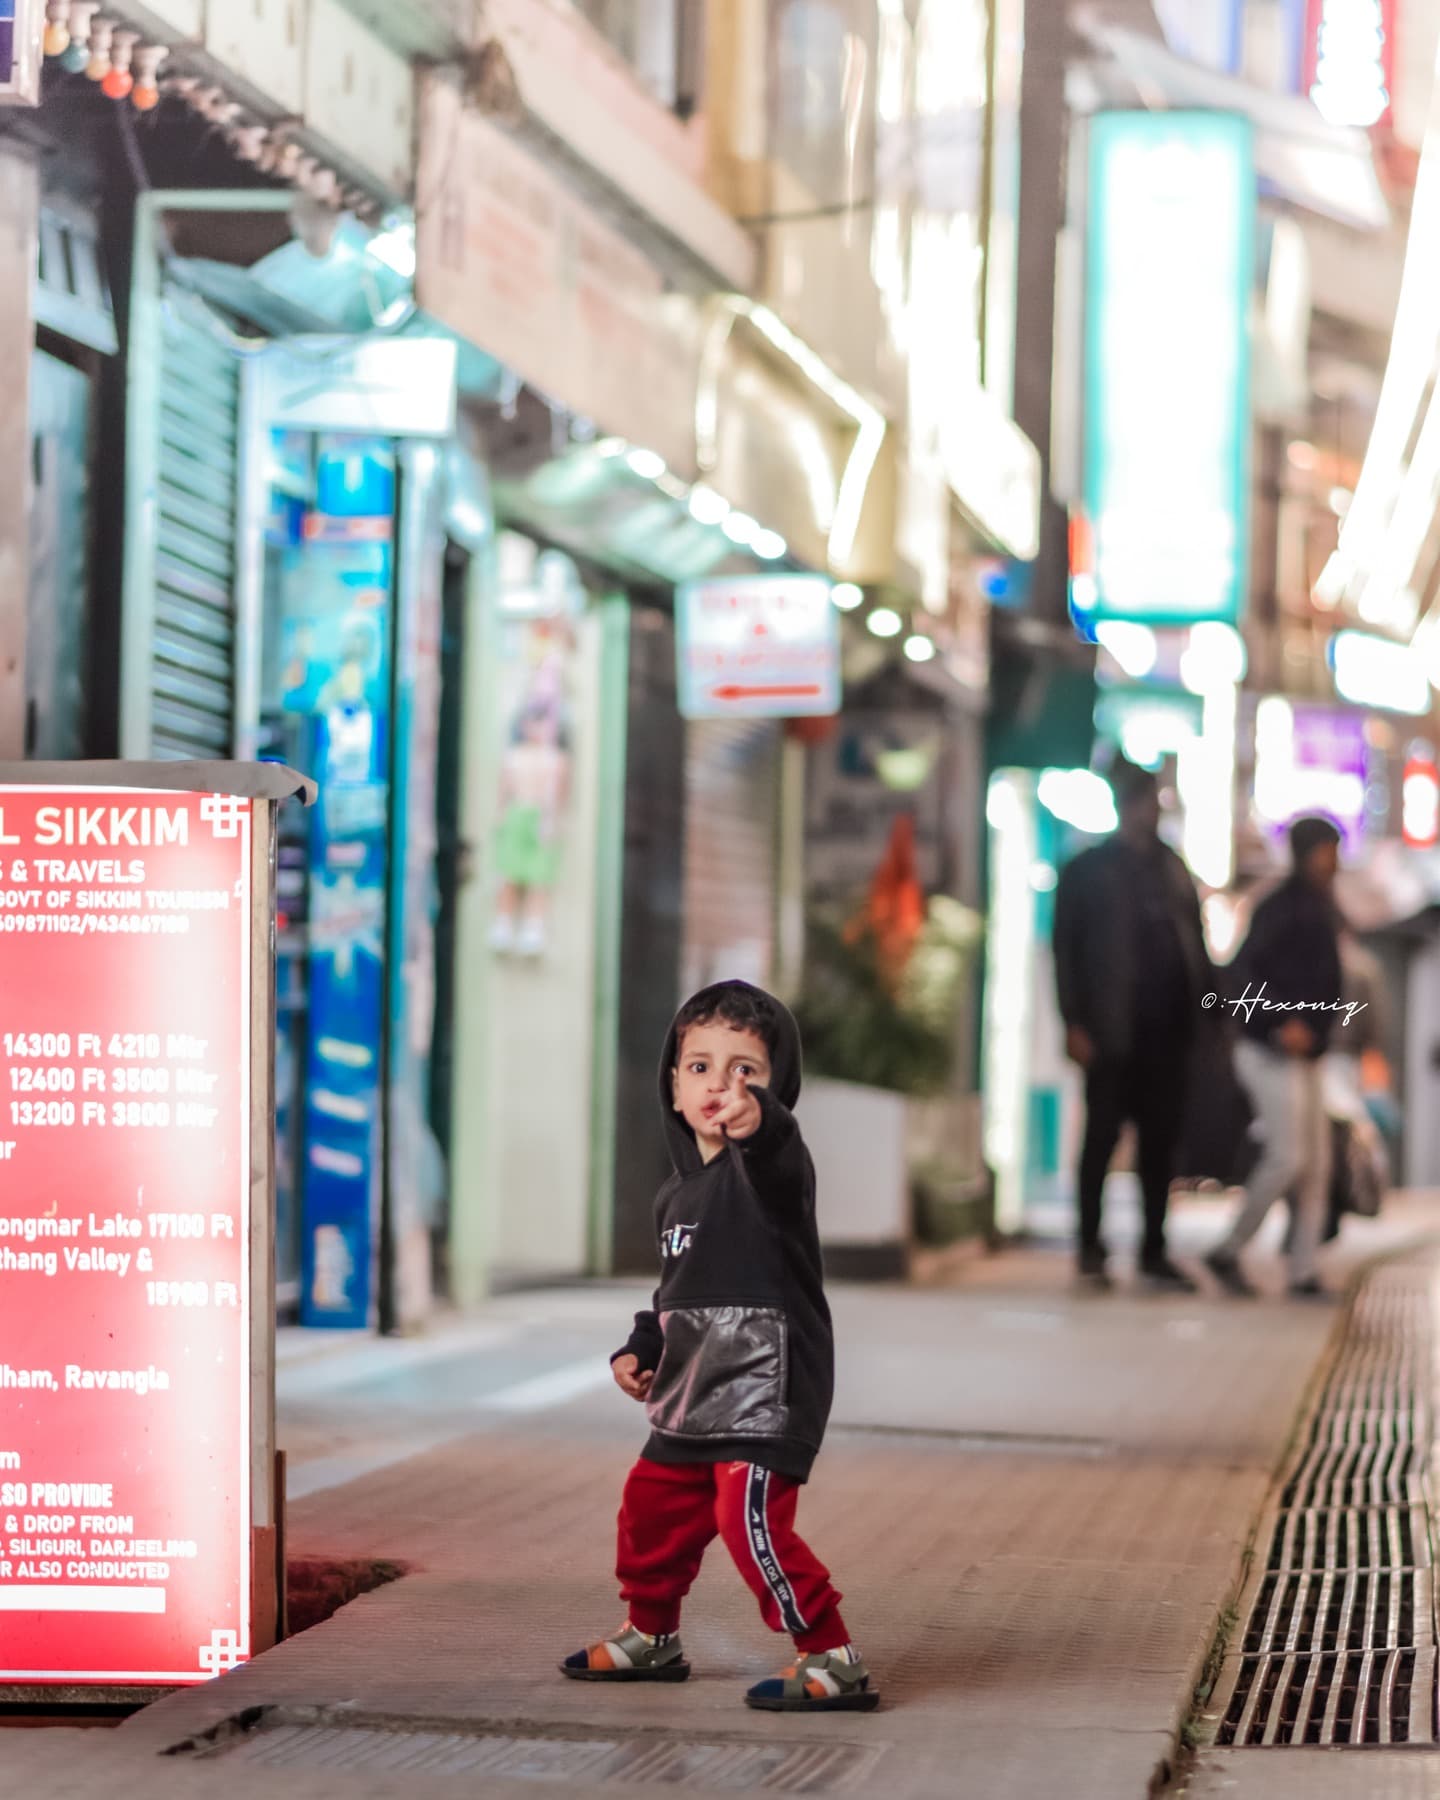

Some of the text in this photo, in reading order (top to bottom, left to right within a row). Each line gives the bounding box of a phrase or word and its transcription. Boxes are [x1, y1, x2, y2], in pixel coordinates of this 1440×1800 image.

[34, 807, 189, 846] SIKKIM
[11, 859, 27, 883] &
[34, 859, 146, 883] TRAVELS
[46, 890, 71, 909] OF
[76, 891, 141, 909] SIKKIM
[4, 1033, 70, 1058] 14300
[78, 1033, 101, 1058] Ft
[107, 1034, 160, 1059] 4210
[10, 1067, 75, 1092] 12400
[83, 1067, 106, 1092] Ft
[10, 1101, 75, 1126] 13200
[83, 1102, 106, 1126] Ft
[89, 1213, 142, 1237] Lake
[148, 1213, 205, 1238] 17100
[211, 1213, 233, 1238] Ft
[63, 1247, 130, 1277] Valley
[136, 1248, 153, 1271] &
[214, 1281, 237, 1307] Ft
[65, 1364, 170, 1395] Ravangla
[31, 1483, 113, 1507] PROVIDE
[5, 1514, 134, 1534] & DROP FROM
[9, 1539, 86, 1558] SILIGURI,
[17, 1561, 62, 1578] ALSO
[67, 1562, 170, 1579] CONDUCTED
